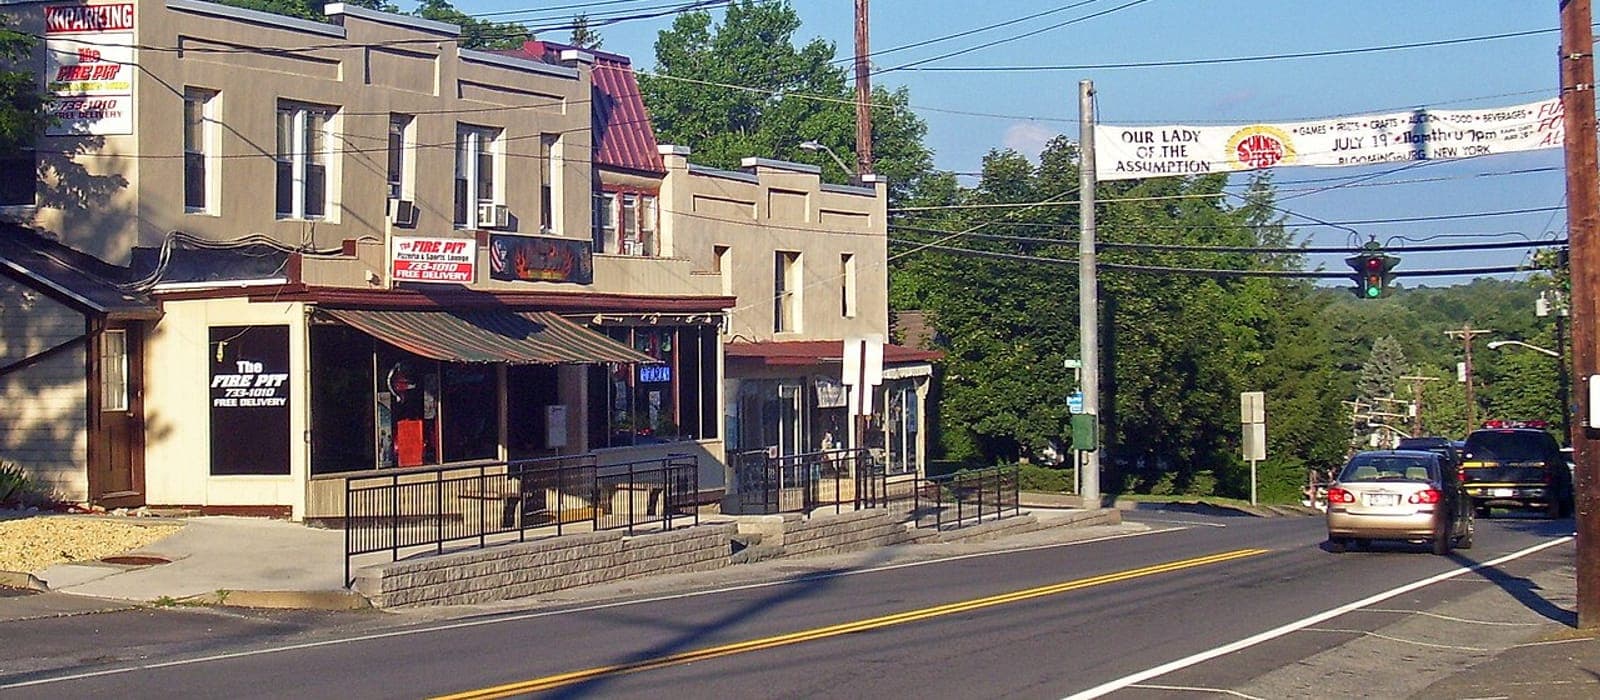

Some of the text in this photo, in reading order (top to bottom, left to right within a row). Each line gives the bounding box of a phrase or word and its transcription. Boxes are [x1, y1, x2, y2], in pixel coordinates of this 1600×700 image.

[66, 5, 133, 30] PARKING
[78, 48, 101, 63] The
[56, 65, 121, 81] FIRE PIT
[60, 99, 117, 110] 733-1010
[1299, 125, 1327, 136] GAMES
[1369, 118, 1398, 130] CRAFTS
[1450, 114, 1473, 124] FOOD
[1482, 109, 1527, 122] BEVERAGES
[1121, 129, 1202, 144] OUR LADY
[1331, 136, 1365, 152] JULY
[1136, 145, 1188, 159] OF THE
[1433, 147, 1458, 159] NEW
[1462, 144, 1491, 156] YORK
[1115, 159, 1211, 173] ASSUMPTION
[411, 241, 442, 253] FIRE
[442, 242, 466, 254] PIT
[407, 262, 459, 272] 733-1010
[396, 270, 469, 280] FREE DELIVERY
[236, 360, 263, 374] The
[210, 373, 289, 388] FIRE PIT
[224, 388, 276, 398] 733-1010
[213, 398, 287, 407] FREE DELIVERY
